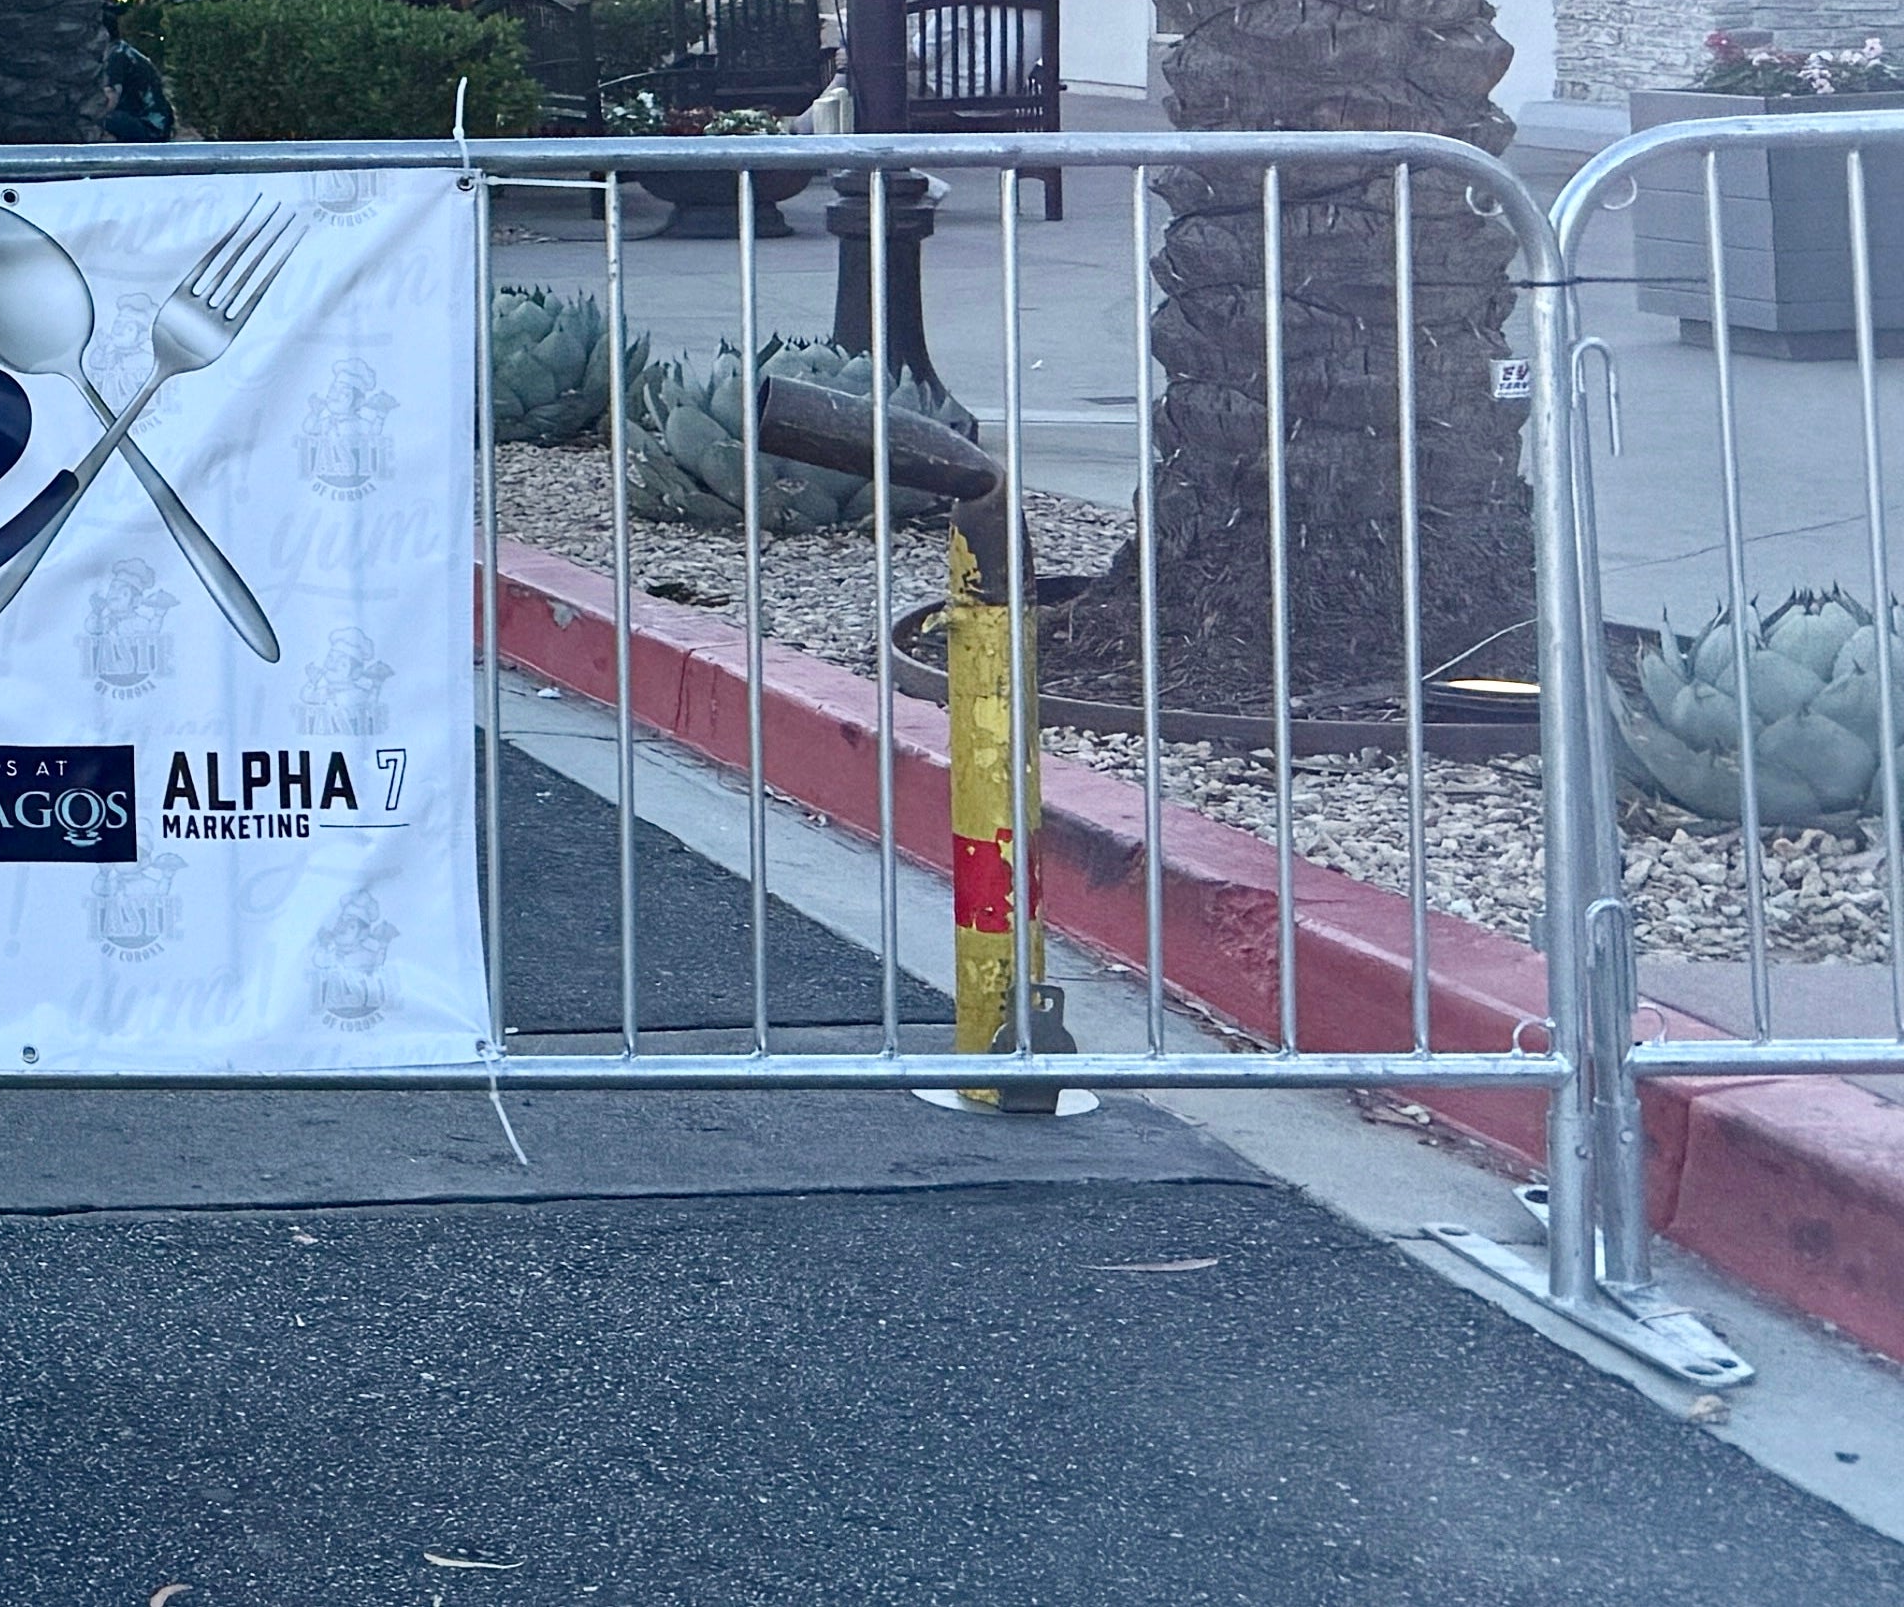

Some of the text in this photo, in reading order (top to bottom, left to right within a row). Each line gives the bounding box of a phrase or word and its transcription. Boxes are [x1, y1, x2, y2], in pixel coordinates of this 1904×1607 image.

[37, 759, 69, 777] AT
[161, 748, 407, 811] ALPHA 7
[162, 813, 311, 840] MARKETING
